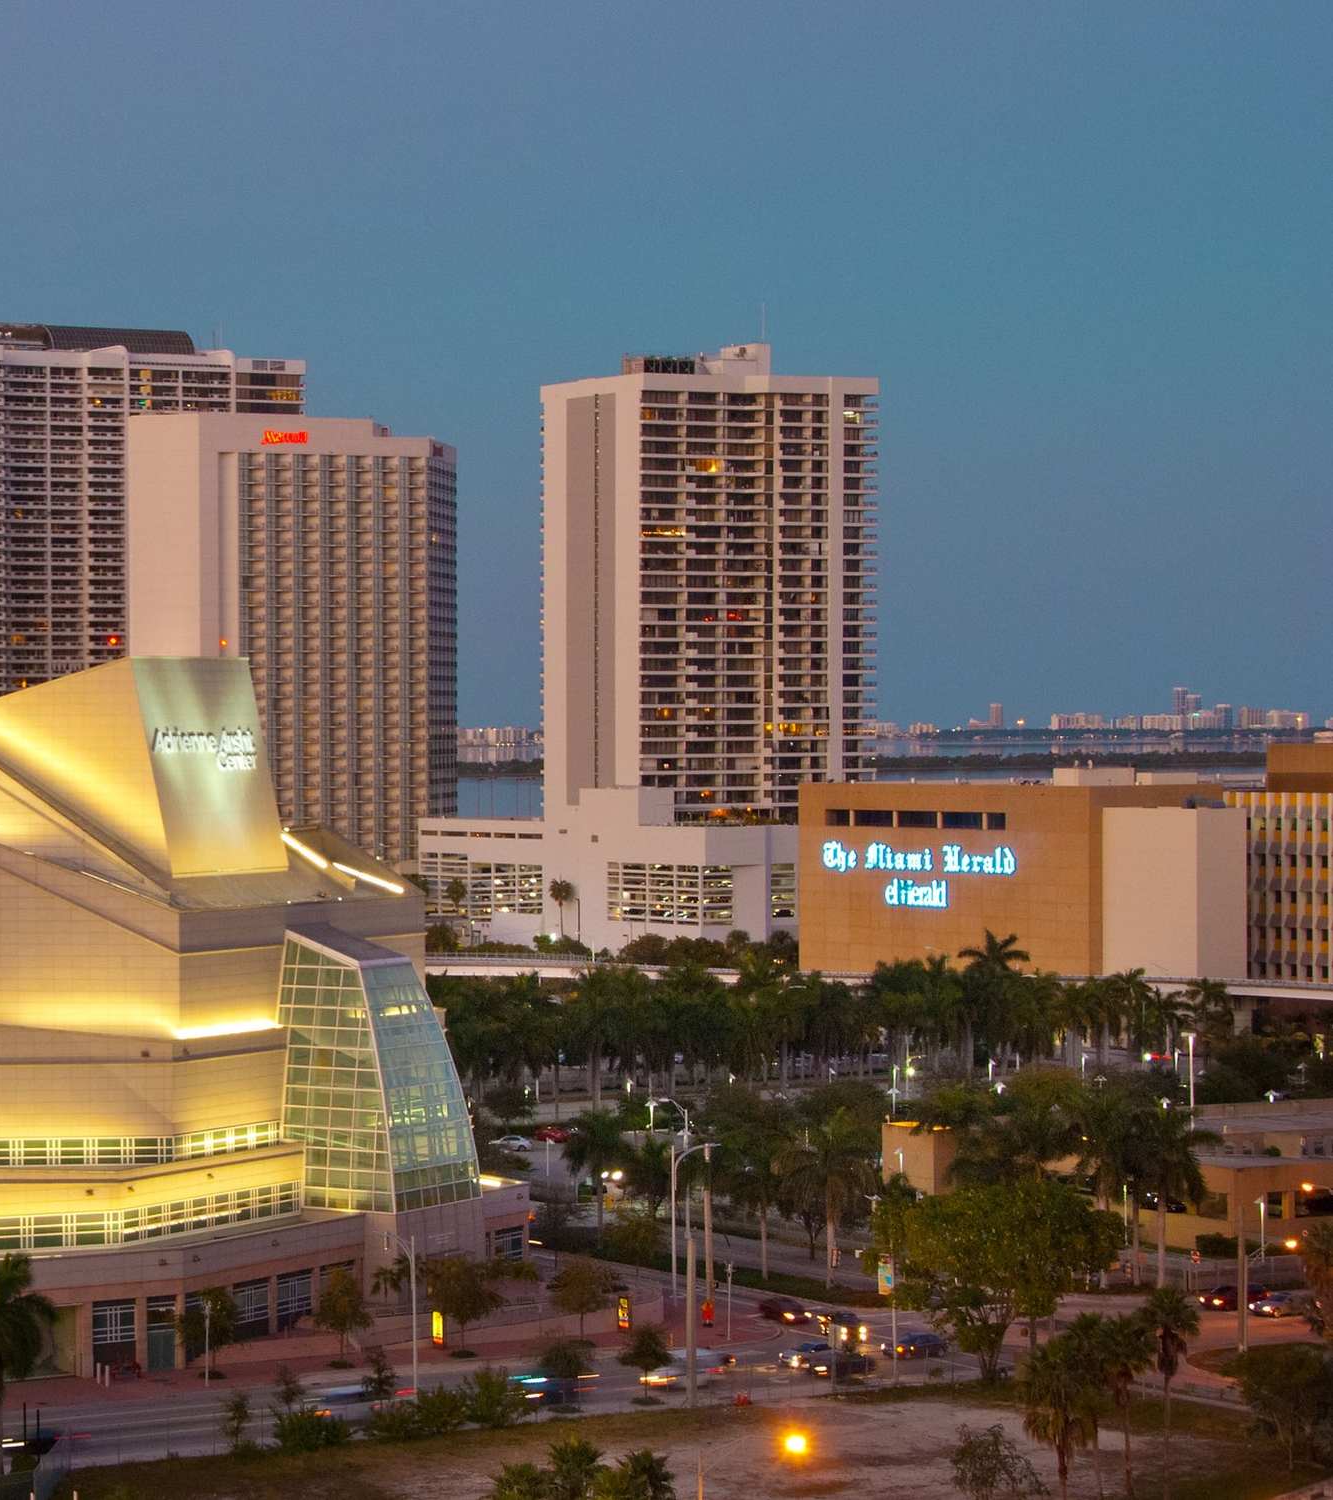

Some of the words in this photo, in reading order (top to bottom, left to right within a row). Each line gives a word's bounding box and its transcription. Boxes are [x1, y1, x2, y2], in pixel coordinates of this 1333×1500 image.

[152, 727, 218, 753] Adrienne
[217, 750, 257, 770] Center
[822, 841, 857, 872] The
[865, 841, 933, 872] Miami
[943, 845, 1017, 875] Herald
